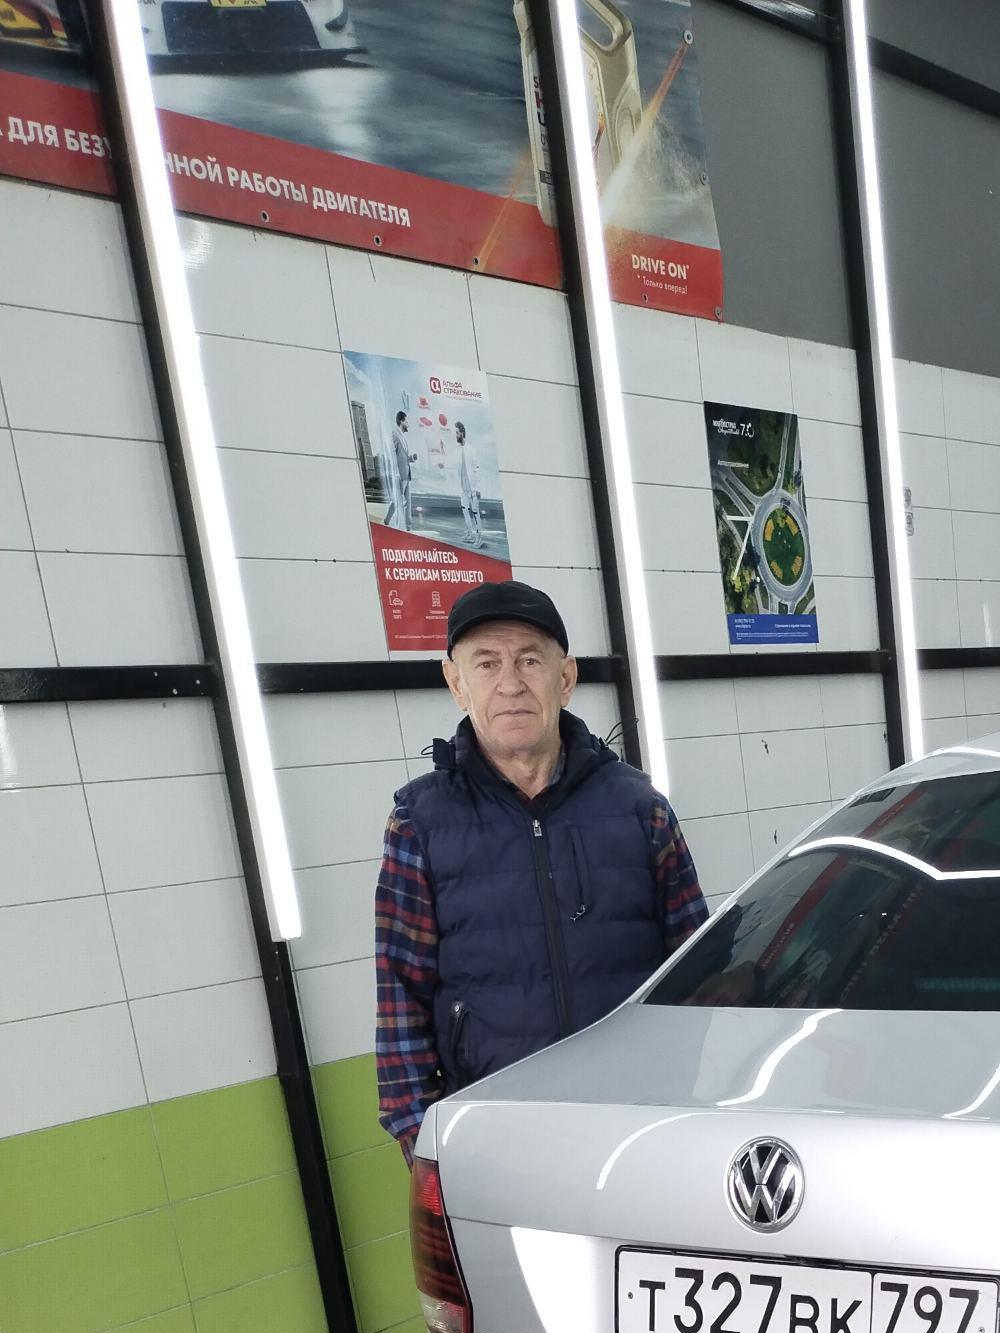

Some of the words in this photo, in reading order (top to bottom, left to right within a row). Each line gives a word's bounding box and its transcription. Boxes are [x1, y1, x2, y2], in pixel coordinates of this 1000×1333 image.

[8, 116, 59, 148] ДЛЯ
[227, 166, 308, 204] РАБОТЫ
[312, 186, 411, 227] ДВИГАТЕЛЯ
[631, 254, 666, 276] DRIVE
[382, 548, 458, 564] ПОДКЛЮЧАЙТЕСЬ
[385, 567, 392, 580] К
[393, 568, 440, 581] СЕРВИСАМ
[441, 569, 483, 584] БУДУЩЕГО
